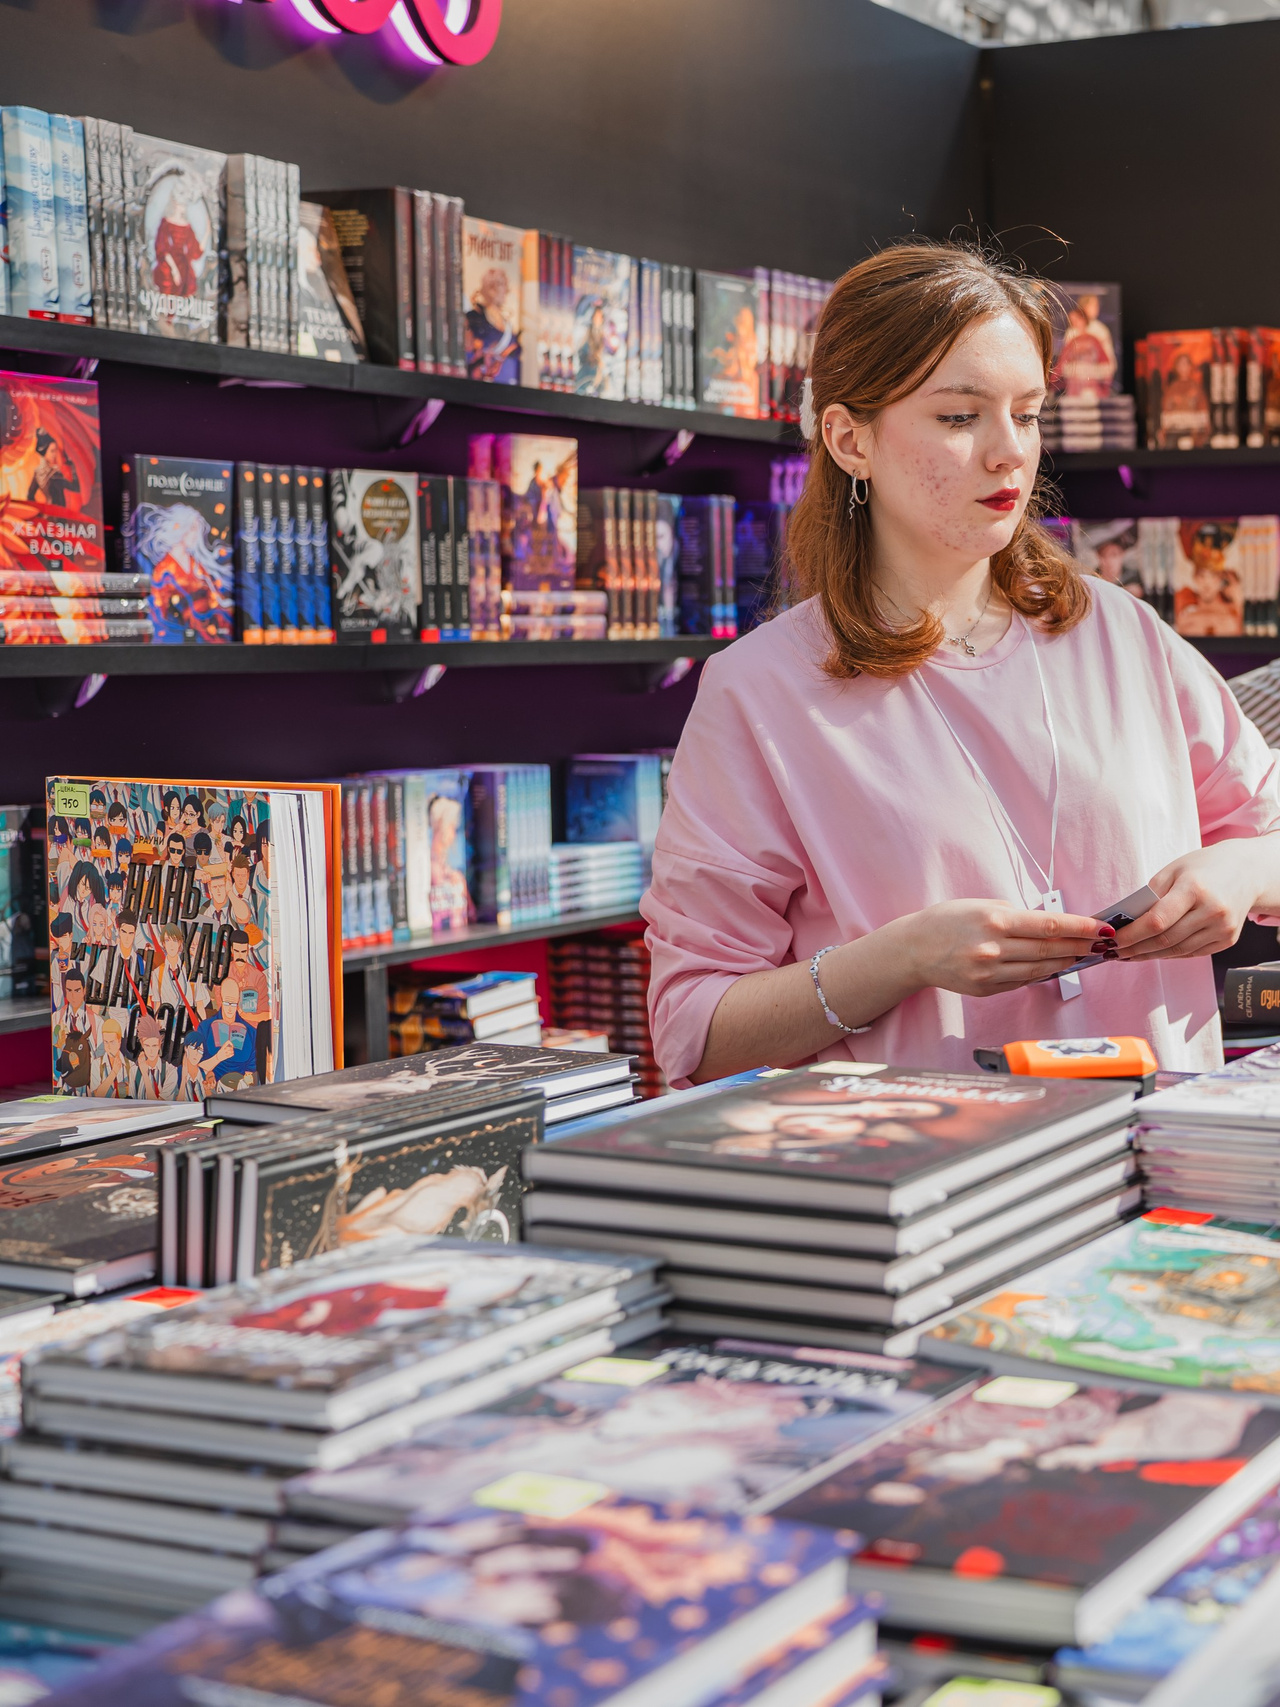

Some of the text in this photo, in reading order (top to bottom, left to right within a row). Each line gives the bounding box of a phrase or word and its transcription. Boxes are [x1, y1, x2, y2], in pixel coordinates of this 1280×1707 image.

[10, 521, 97, 539] ЖЕЛЕЗНАЯ
[29, 539, 86, 556] ВДОВА
[61, 797, 79, 809] 750
[133, 835, 164, 846] БРАУНИ
[124, 862, 201, 927] НАНЬ
[181, 921, 234, 986] ХАО
[1246, 975, 1254, 1018] СЕЛЮТИНА
